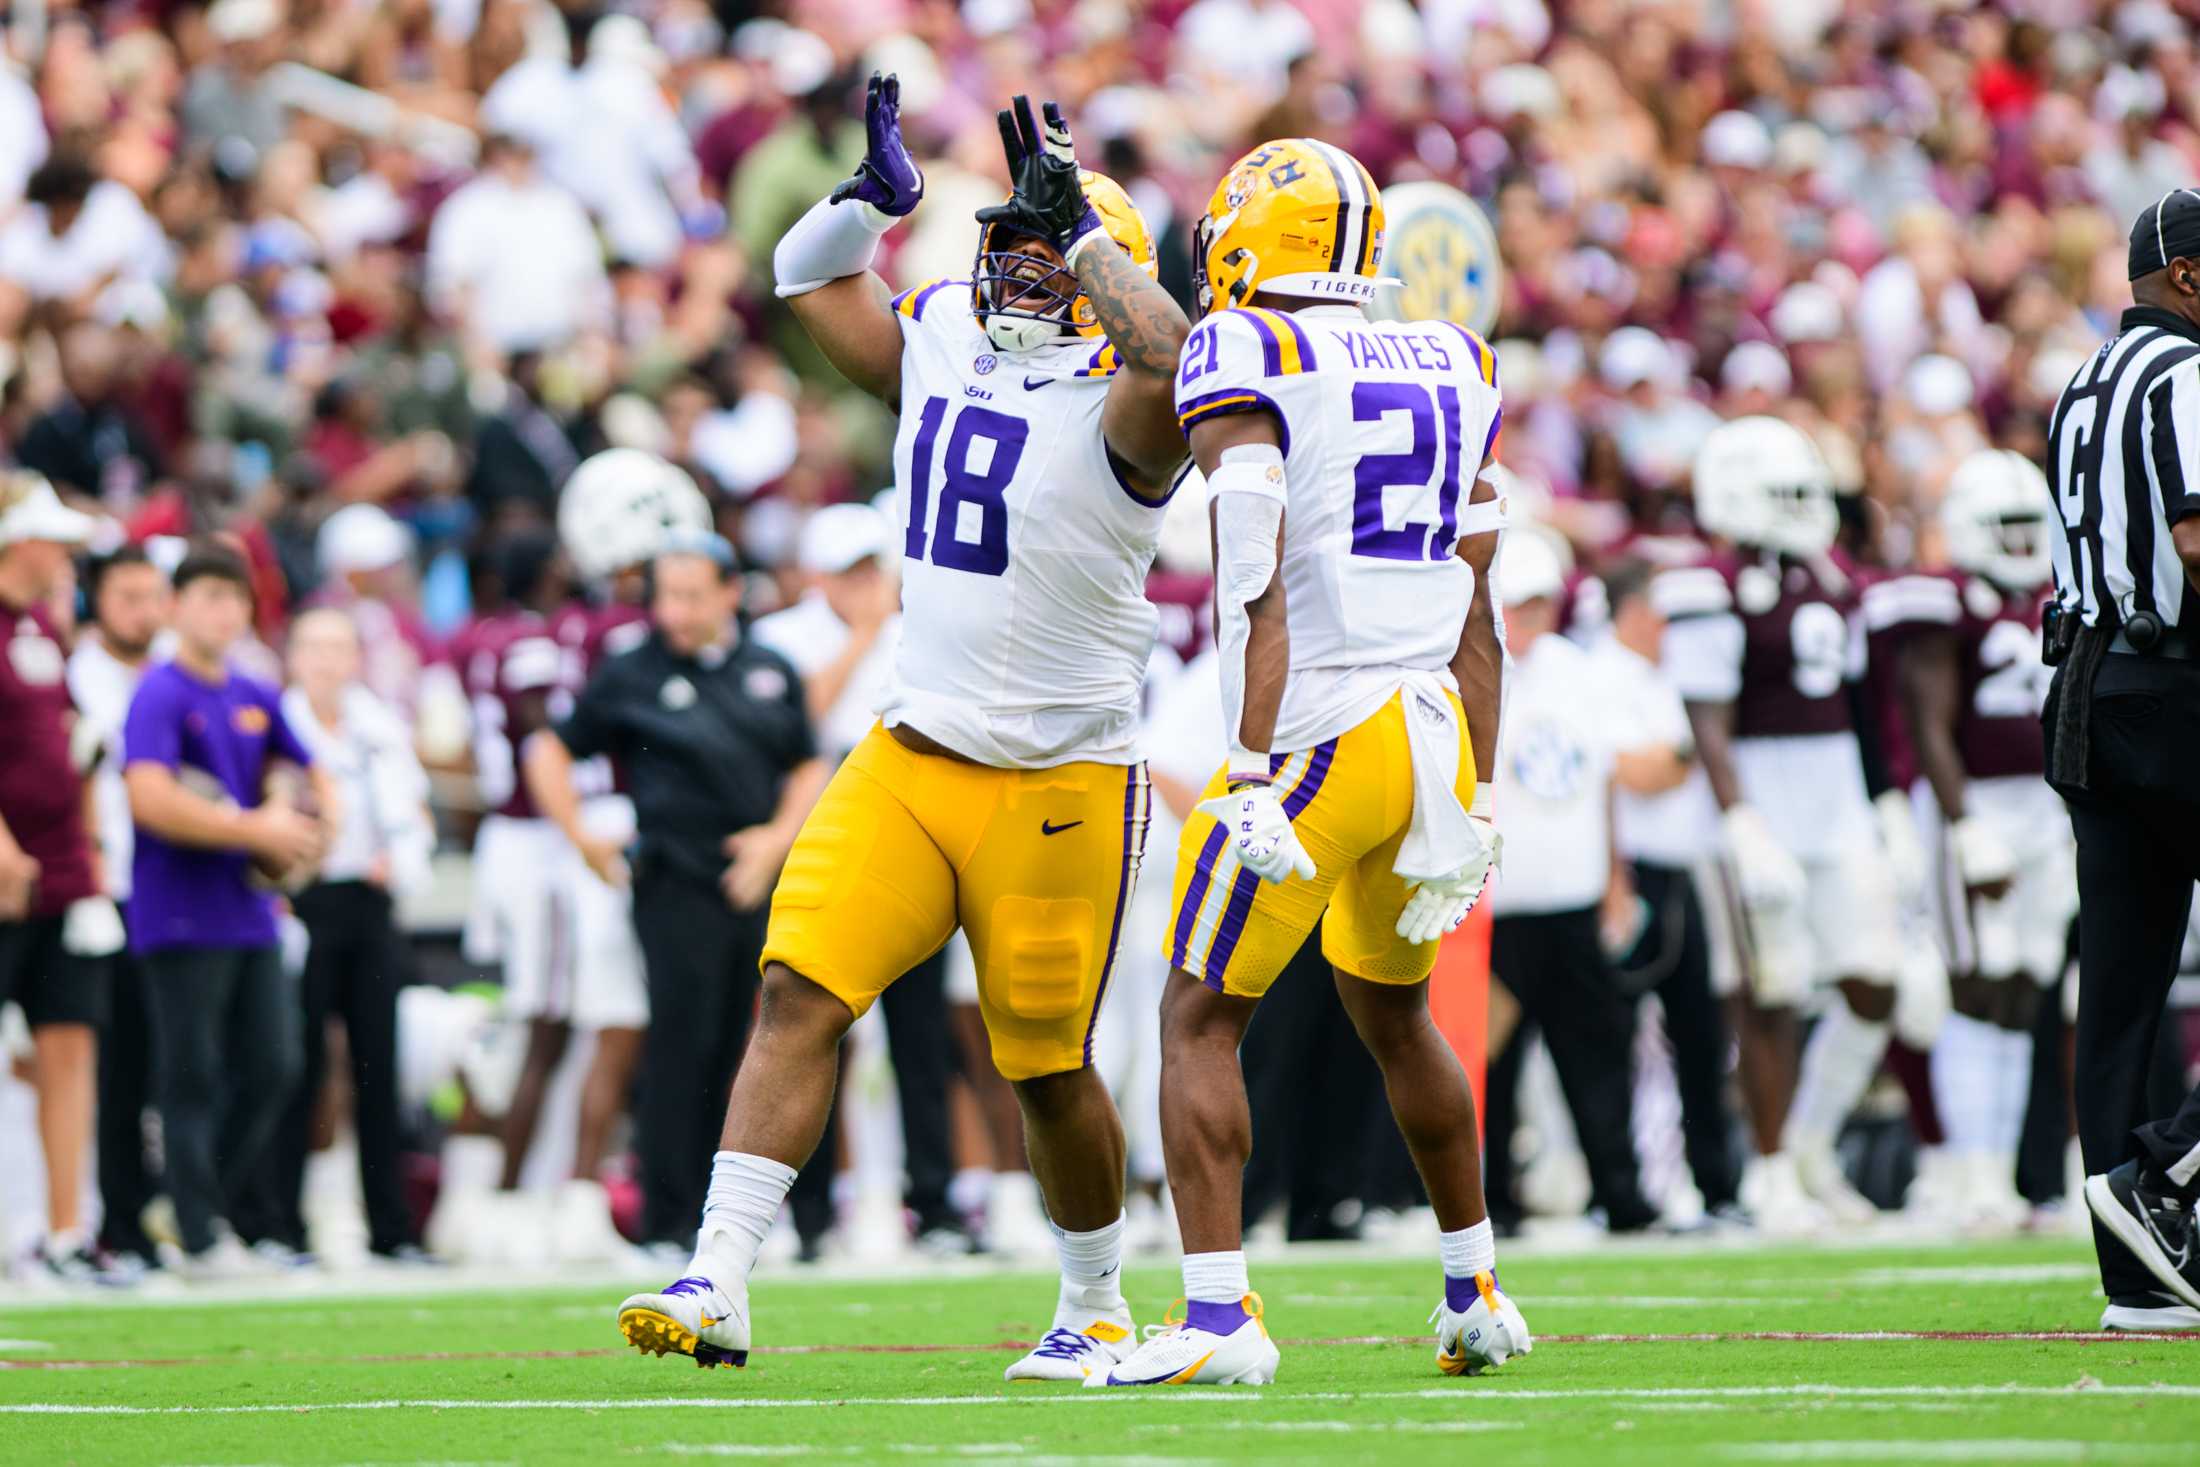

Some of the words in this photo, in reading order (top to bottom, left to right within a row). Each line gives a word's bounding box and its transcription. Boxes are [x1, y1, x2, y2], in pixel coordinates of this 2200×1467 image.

[1310, 279, 1376, 299] TIGERS
[1181, 322, 1219, 387] 21
[1331, 331, 1452, 371] YAITES
[905, 395, 1030, 577] 18
[1351, 381, 1462, 562] 21
